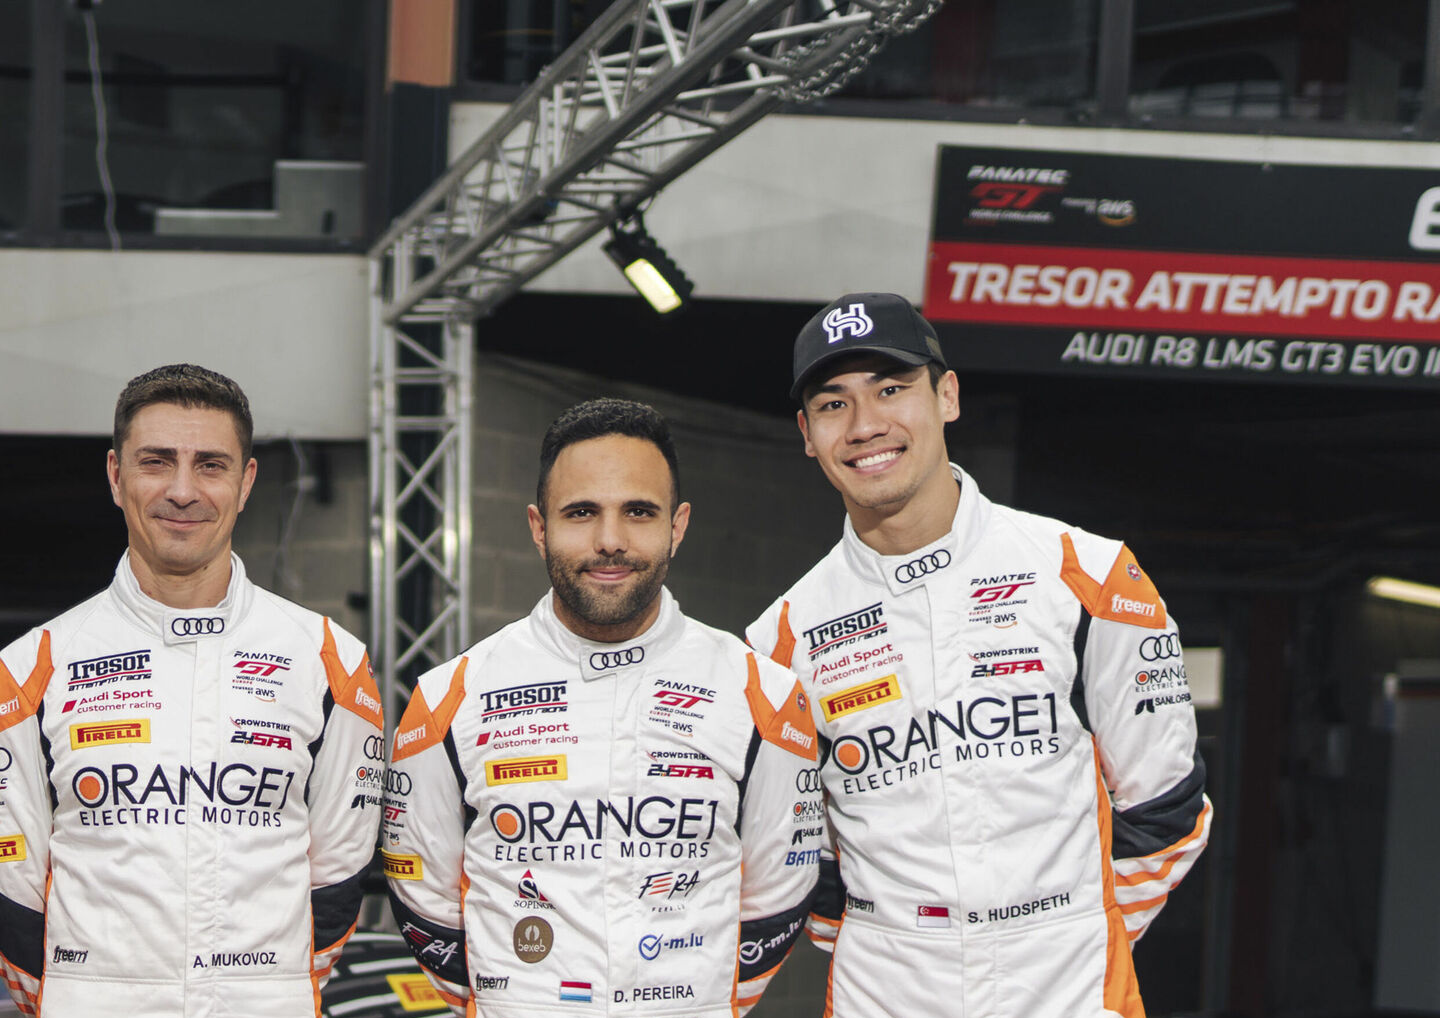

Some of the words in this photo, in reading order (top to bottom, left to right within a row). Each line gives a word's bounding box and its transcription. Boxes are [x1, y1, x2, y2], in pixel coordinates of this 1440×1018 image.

[947, 261, 1133, 310] TRESOR
[1134, 270, 1390, 320] ATTEMPTO
[1061, 332, 1147, 364] AUDI
[1150, 335, 1199, 367] R8
[1203, 338, 1277, 370] LMS
[1280, 341, 1346, 373] GT3
[1348, 344, 1420, 376] EVO
[970, 572, 1037, 586] FANATEC
[973, 603, 995, 611] WORLD
[995, 599, 1028, 608] CHALLENGE
[1111, 593, 1156, 617] freem
[803, 601, 884, 650] Tresor
[994, 612, 1017, 624] aws
[233, 650, 292, 666] FANATEC
[820, 655, 852, 675] Audi
[853, 643, 893, 662] Sport
[973, 647, 1040, 659] CROWDSTRIKE
[67, 649, 151, 681] Tresor
[821, 664, 871, 685] customer
[872, 652, 904, 671] racing
[255, 676, 283, 686] CHALLENGE
[654, 679, 716, 697] FANATEC
[1135, 683, 1173, 692] ELECTRIC
[79, 691, 109, 706] Audi
[112, 688, 153, 700] Sport
[255, 687, 275, 698] aws
[355, 686, 381, 716] freem
[480, 680, 568, 712] Tresor
[827, 681, 892, 715] PIRELLI
[77, 703, 128, 714] customer
[129, 700, 162, 710] racing
[77, 723, 142, 743] PIRELLI
[235, 718, 291, 732] CROWDSTRIKE
[493, 725, 525, 740] Audi
[528, 722, 569, 734] Sport
[672, 721, 693, 733] aws
[781, 721, 813, 749] freem
[832, 692, 1058, 775] ORANGE1
[397, 724, 426, 751] freem
[493, 737, 543, 749] customer
[545, 734, 578, 744] racing
[493, 760, 558, 780] PIRELLI
[844, 753, 942, 795] ELECTRIC
[956, 737, 1060, 762] MOTORS
[72, 762, 294, 809] ORANGE1
[80, 808, 186, 826] ELECTRIC
[202, 806, 282, 827] MOTORS
[490, 796, 719, 843] ORANGE1
[495, 844, 603, 863] ELECTRIC
[620, 842, 709, 859] MOTORS
[968, 911, 984, 923] S.
[988, 892, 1071, 922] HUDSPETH
[53, 944, 88, 964] freem
[518, 938, 546, 954] bexeb
[193, 955, 208, 969] A.
[211, 952, 277, 967] MUKOVOZ
[476, 973, 509, 992] freem
[614, 990, 628, 1003] D.
[633, 984, 695, 1001] PEREIRA
